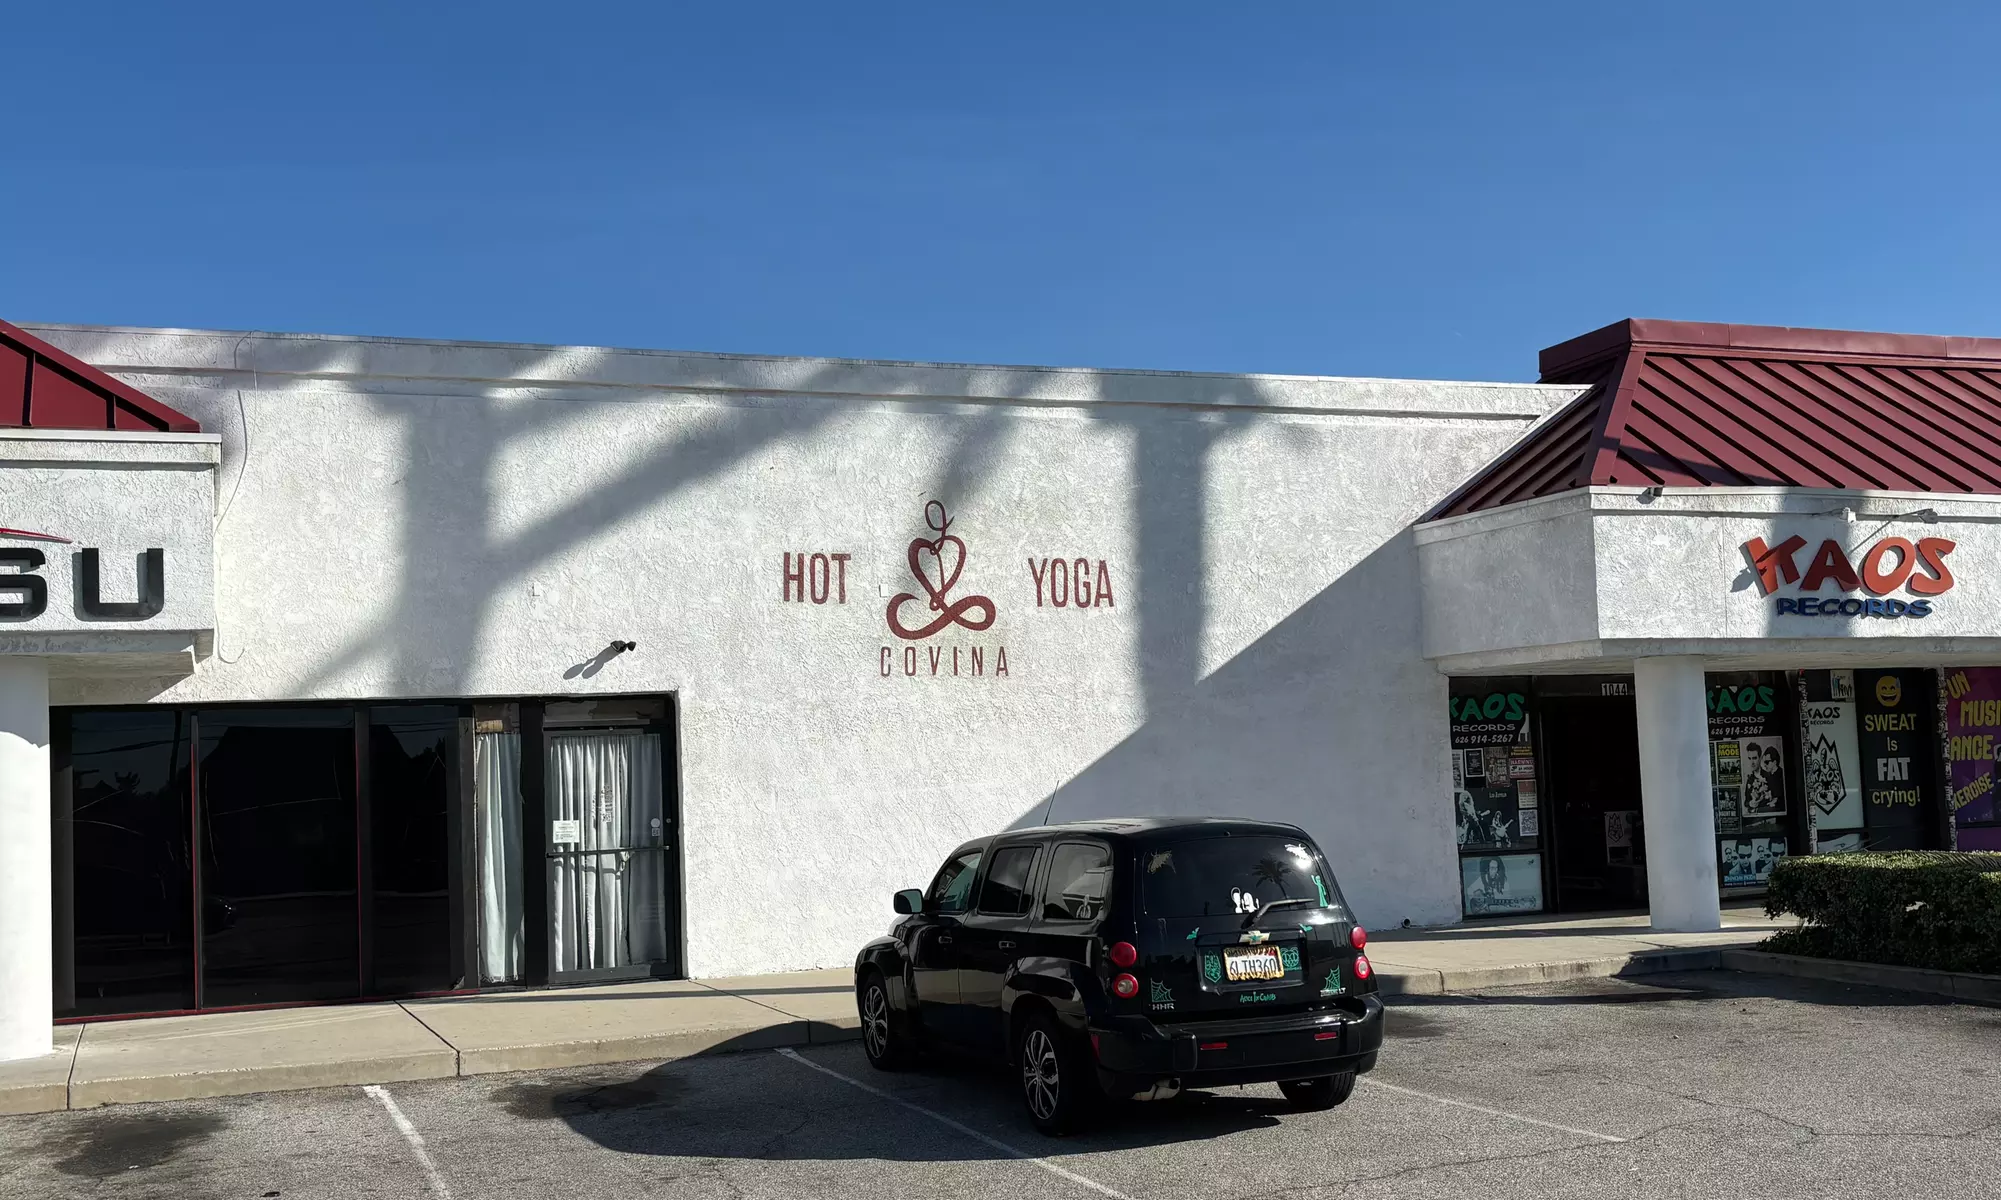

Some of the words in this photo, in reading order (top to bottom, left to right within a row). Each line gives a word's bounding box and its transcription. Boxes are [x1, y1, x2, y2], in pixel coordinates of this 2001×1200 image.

[1740, 534, 1957, 597] KAOS
[783, 551, 851, 604] HOT
[1028, 557, 1115, 608] YOGA
[1775, 597, 1934, 619] RECORDS
[880, 646, 1009, 677] COVINA
[1601, 682, 1628, 696] 1044
[1944, 670, 1972, 699] UN
[1709, 716, 1766, 725] RECORDS
[1864, 714, 1917, 731] SWEAT
[1960, 700, 2001, 728] MUSI
[1452, 723, 1516, 733] RECORDS
[1455, 736, 1469, 744] 626
[1470, 734, 1514, 744] 914-5267
[1725, 726, 1763, 735] 914-5267
[1950, 735, 1993, 761] ANCE
[1876, 757, 1911, 781] FAT
[1872, 786, 1921, 807] crying!
